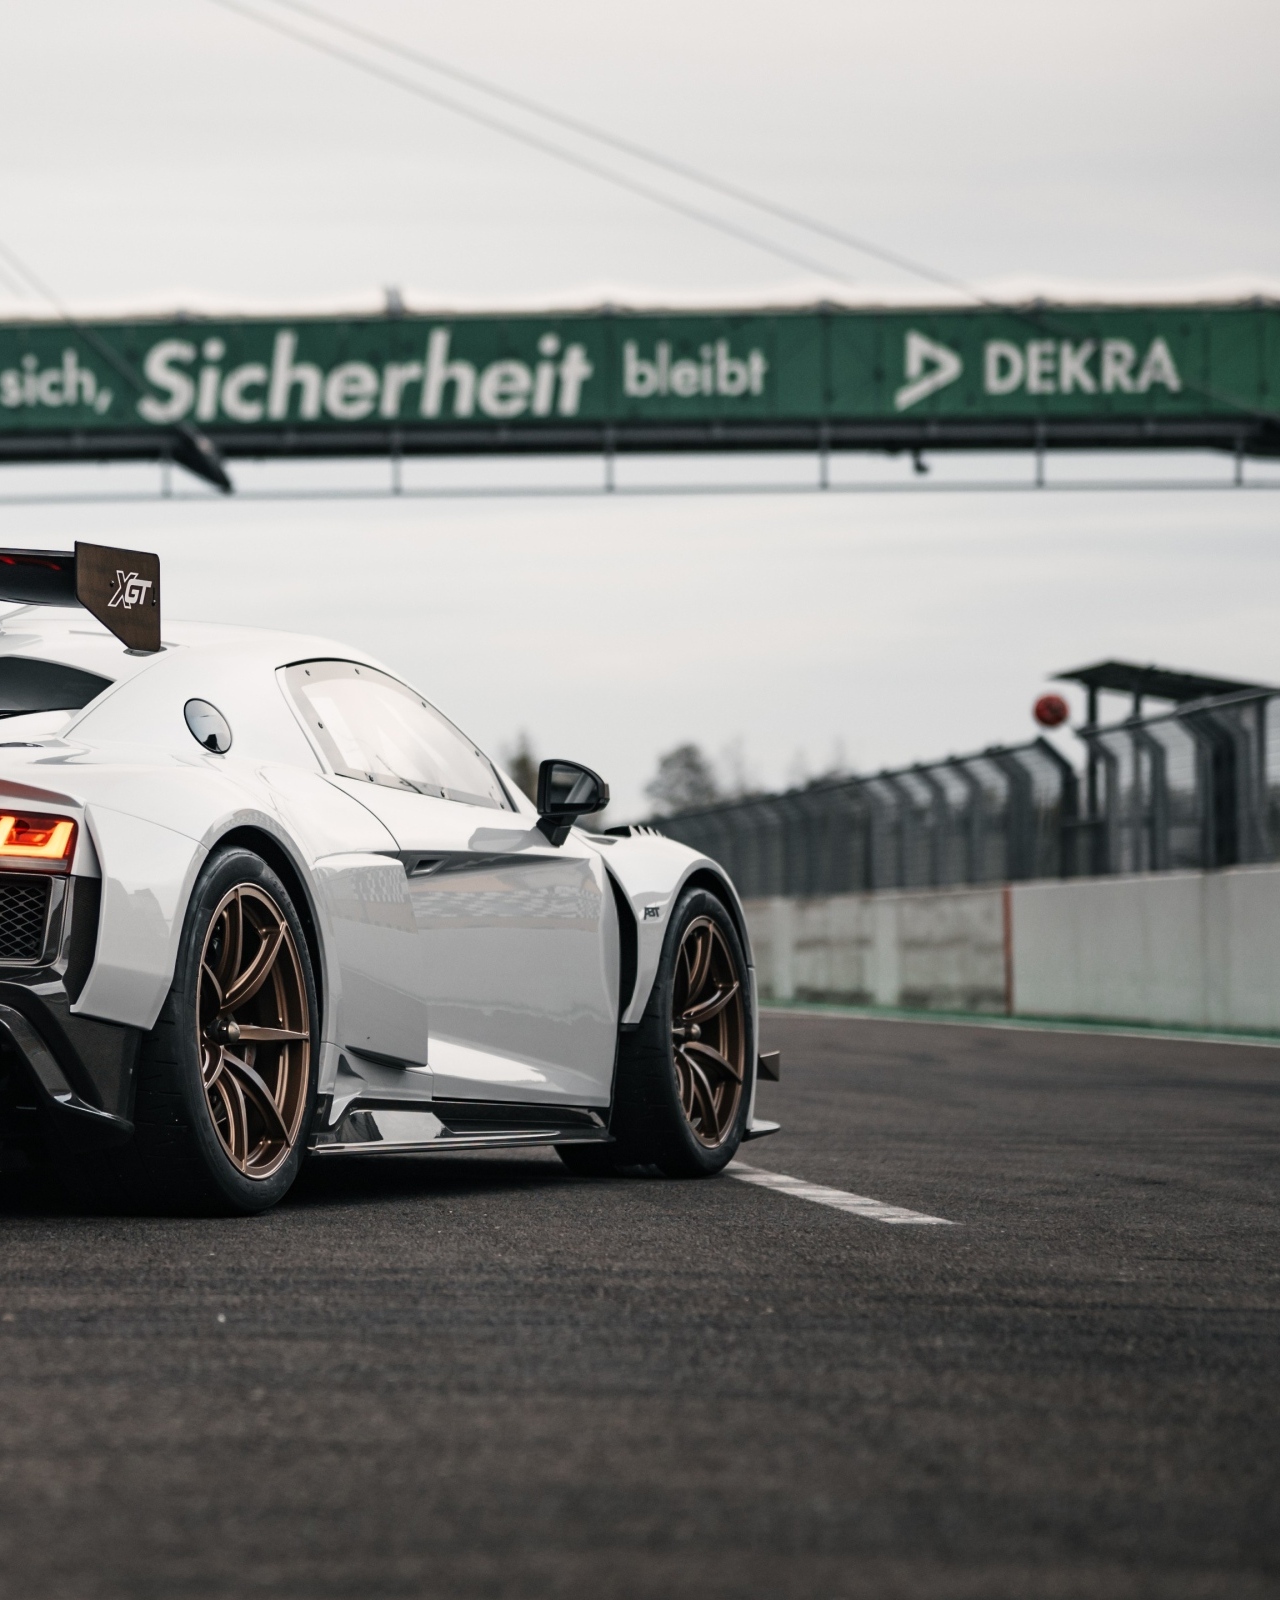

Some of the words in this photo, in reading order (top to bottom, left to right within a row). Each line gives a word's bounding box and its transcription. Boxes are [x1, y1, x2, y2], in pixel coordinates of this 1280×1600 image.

[0, 349, 111, 414] sich,
[138, 327, 593, 423] Sicherheit
[623, 339, 768, 398] bleibt
[983, 337, 1182, 395] DEKRA
[107, 570, 152, 609] XGT
[643, 906, 660, 920] ABT
